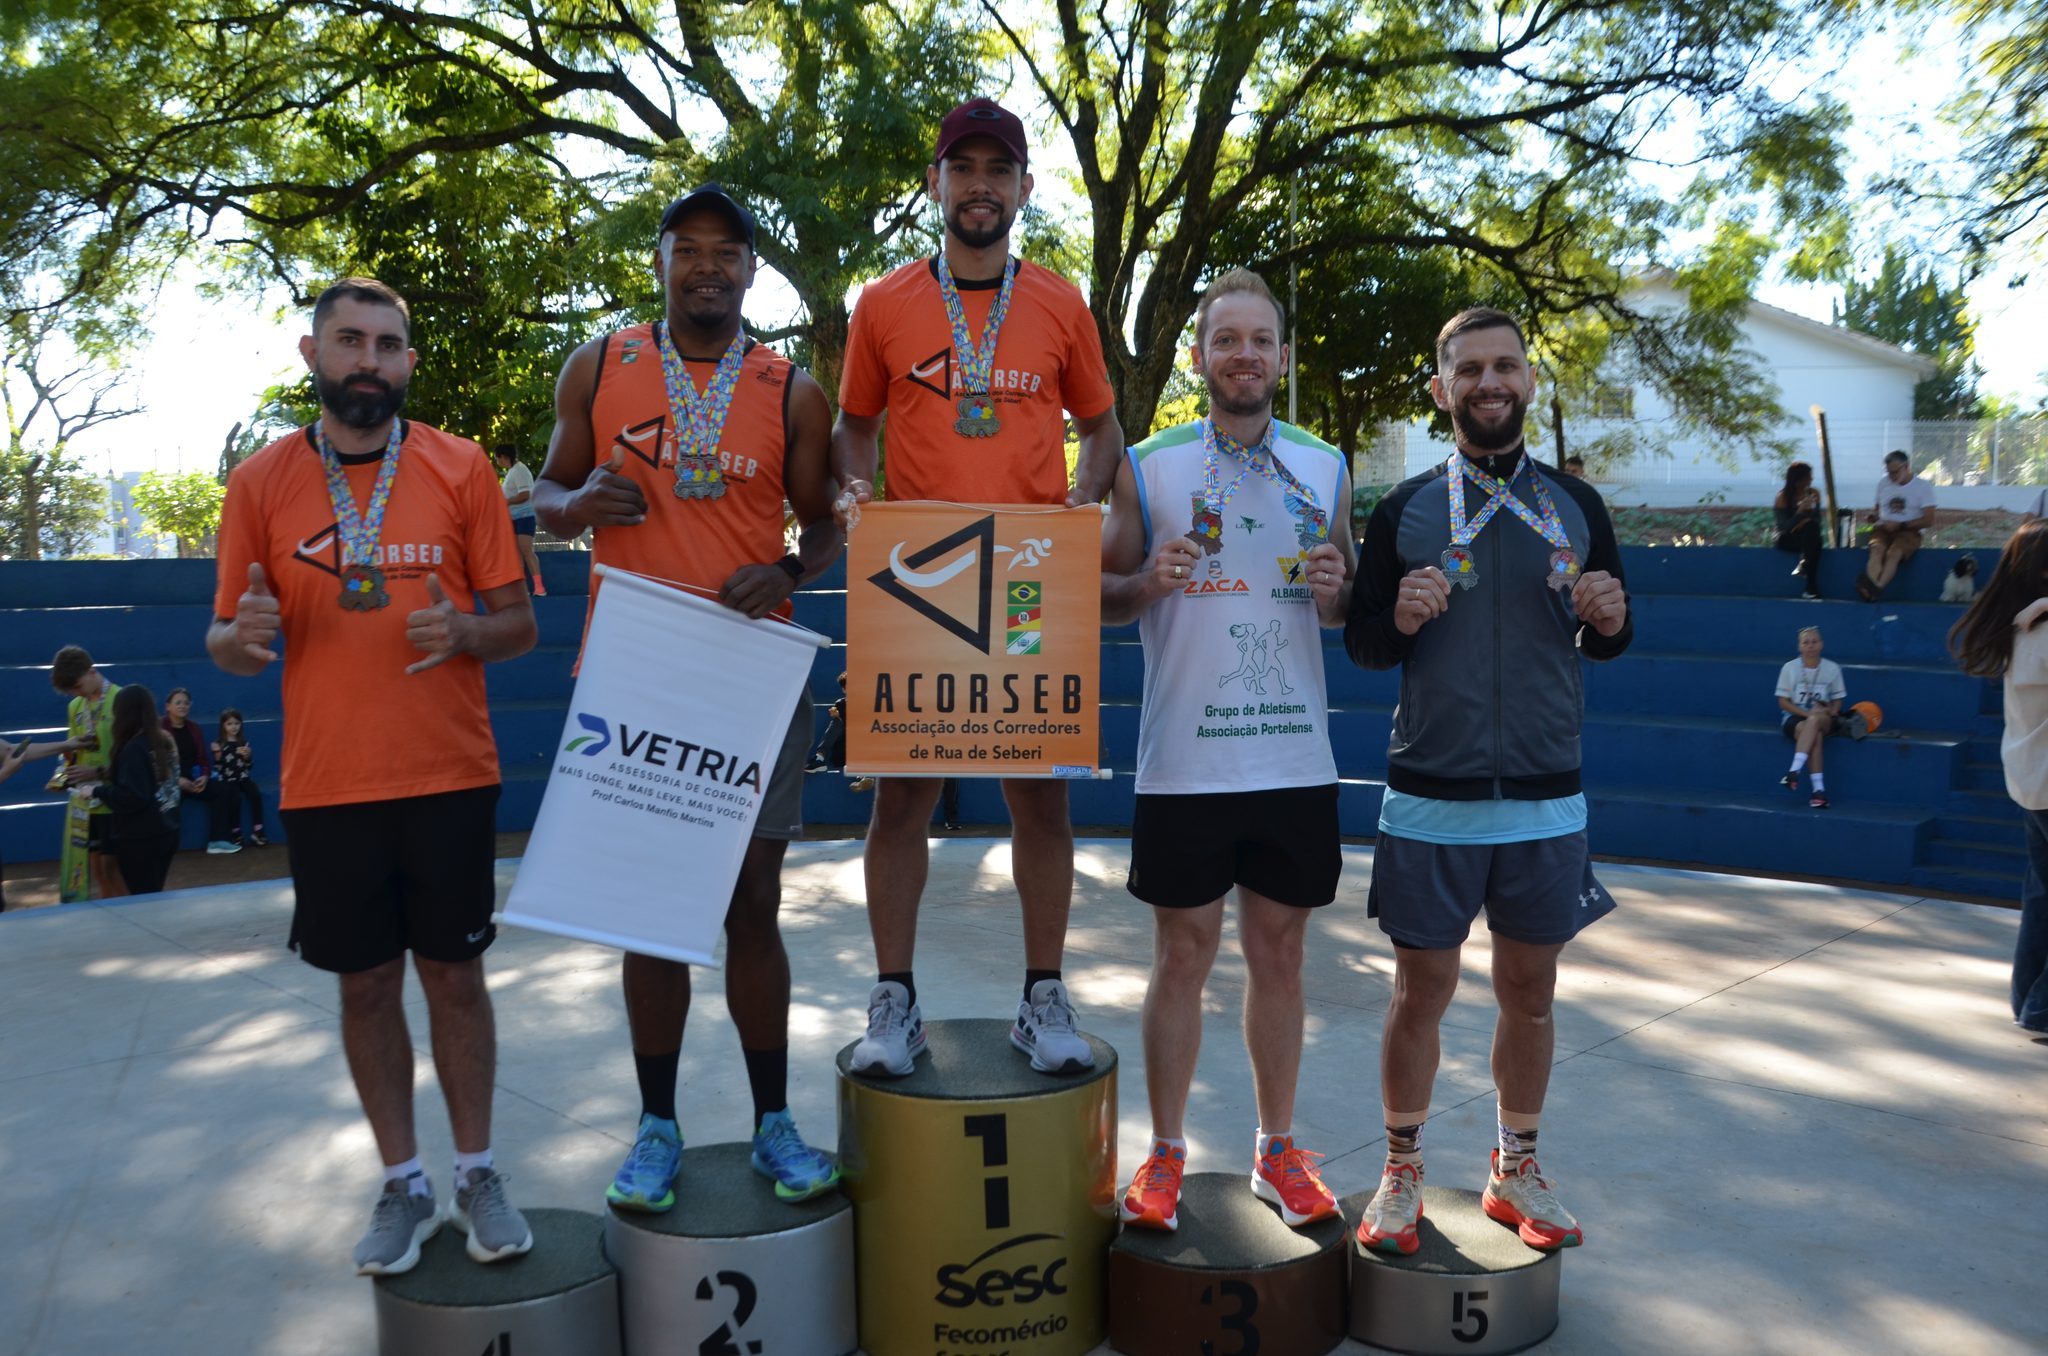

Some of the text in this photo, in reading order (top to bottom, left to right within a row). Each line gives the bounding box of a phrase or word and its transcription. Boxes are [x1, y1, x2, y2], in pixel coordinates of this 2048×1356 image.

[952, 369, 1041, 392] ARSEB
[662, 441, 757, 478] ASEB
[1183, 578, 1249, 594] ZACA
[873, 672, 1081, 714] ACORSEB
[1205, 702, 1306, 720] Grupo de Atletismo
[870, 719, 1081, 737] Associação dos Corredores
[1196, 721, 1313, 739] Associação Portelense
[619, 723, 761, 794] VETRIA
[909, 744, 1042, 760] de Rua de Seberi
[558, 765, 584, 778] MAIS
[627, 783, 654, 797] MAIS
[688, 798, 713, 812] MAIS
[609, 762, 753, 808] ASSESSORIA DE CORRIDA
[592, 788, 613, 802] Prof
[614, 795, 644, 810] Carlos
[680, 812, 715, 828] Martins
[963, 1113, 1010, 1230] 1
[934, 1256, 1068, 1308] Sesc
[695, 1270, 763, 1356] 2
[934, 1314, 1068, 1344] Fecomércio
[1201, 1280, 1262, 1356] 3
[1451, 1290, 1489, 1344] 5
